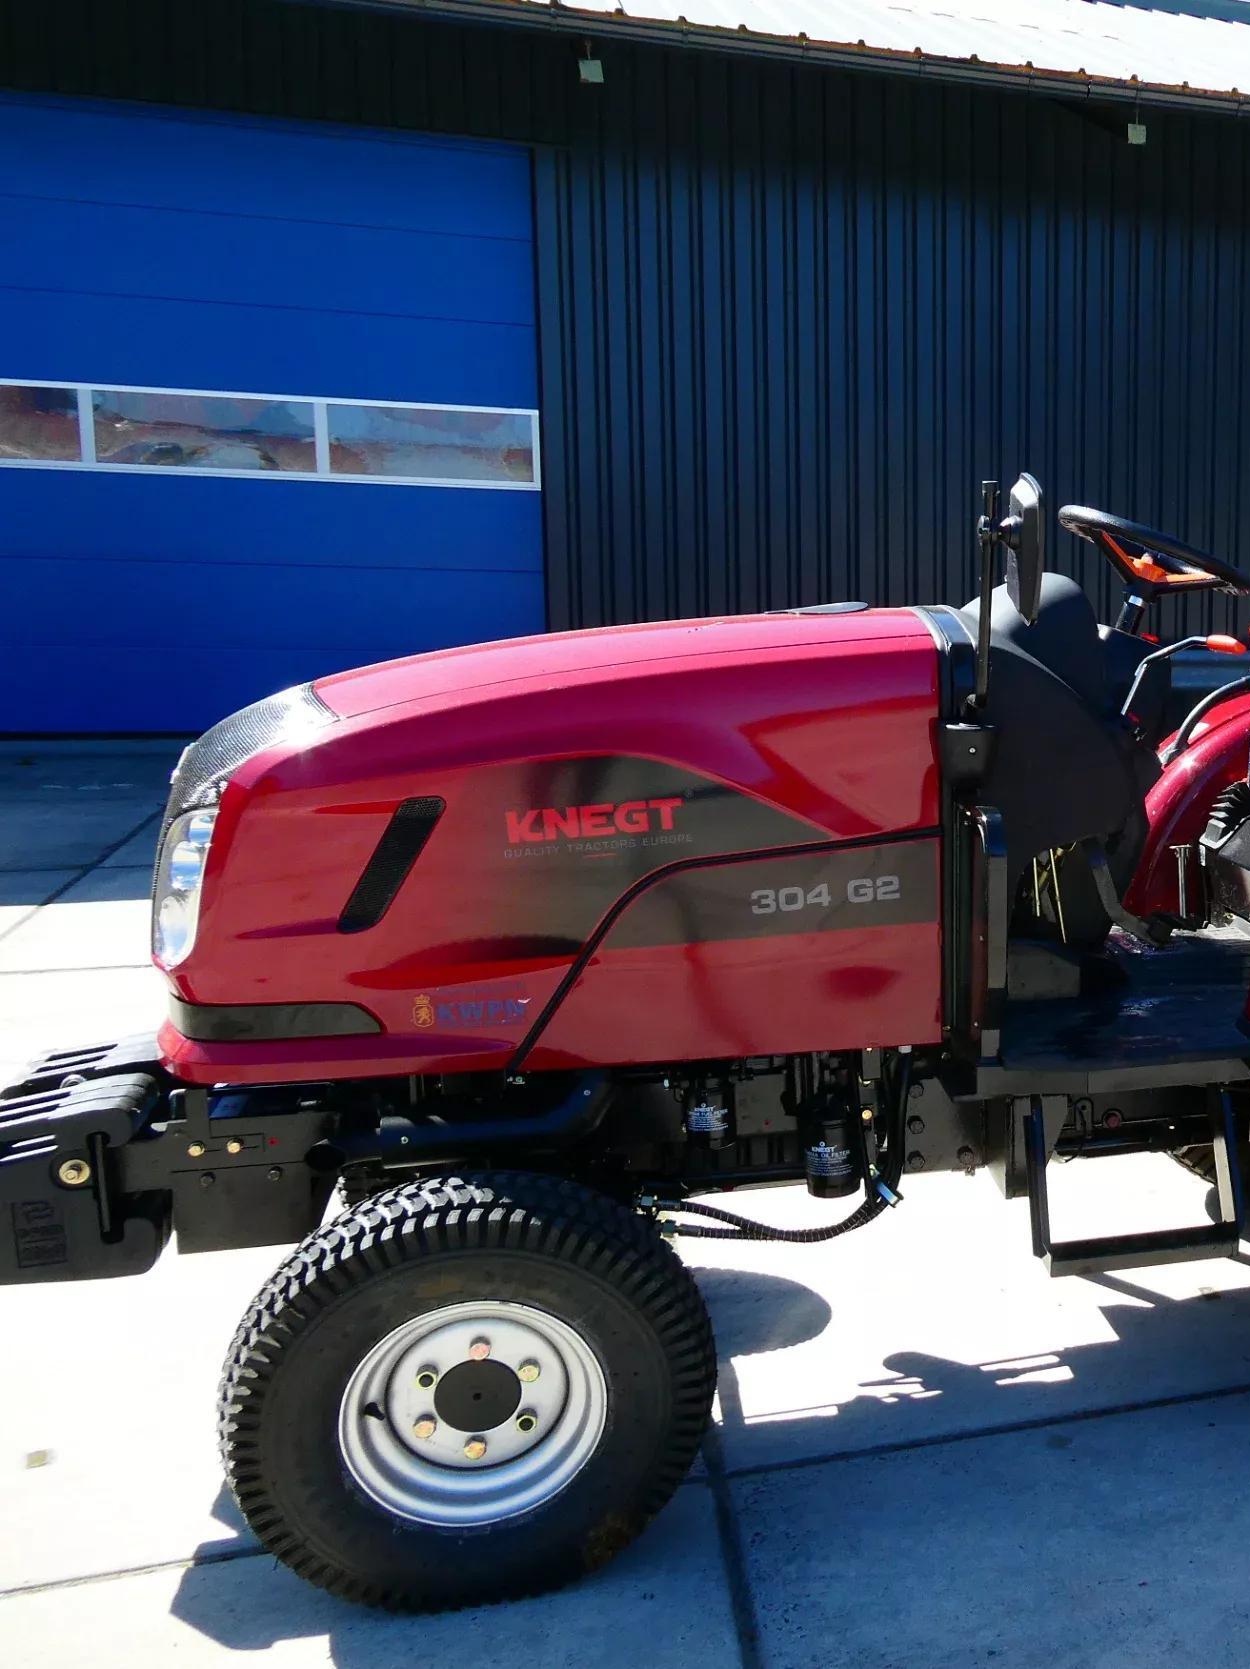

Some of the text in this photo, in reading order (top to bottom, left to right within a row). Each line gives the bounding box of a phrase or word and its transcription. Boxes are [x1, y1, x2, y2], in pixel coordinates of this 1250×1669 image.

[505, 797, 682, 843] KNEGT
[504, 832, 694, 858] QUALITY TRACTORS EUROPE
[751, 875, 901, 914] 304 G2
